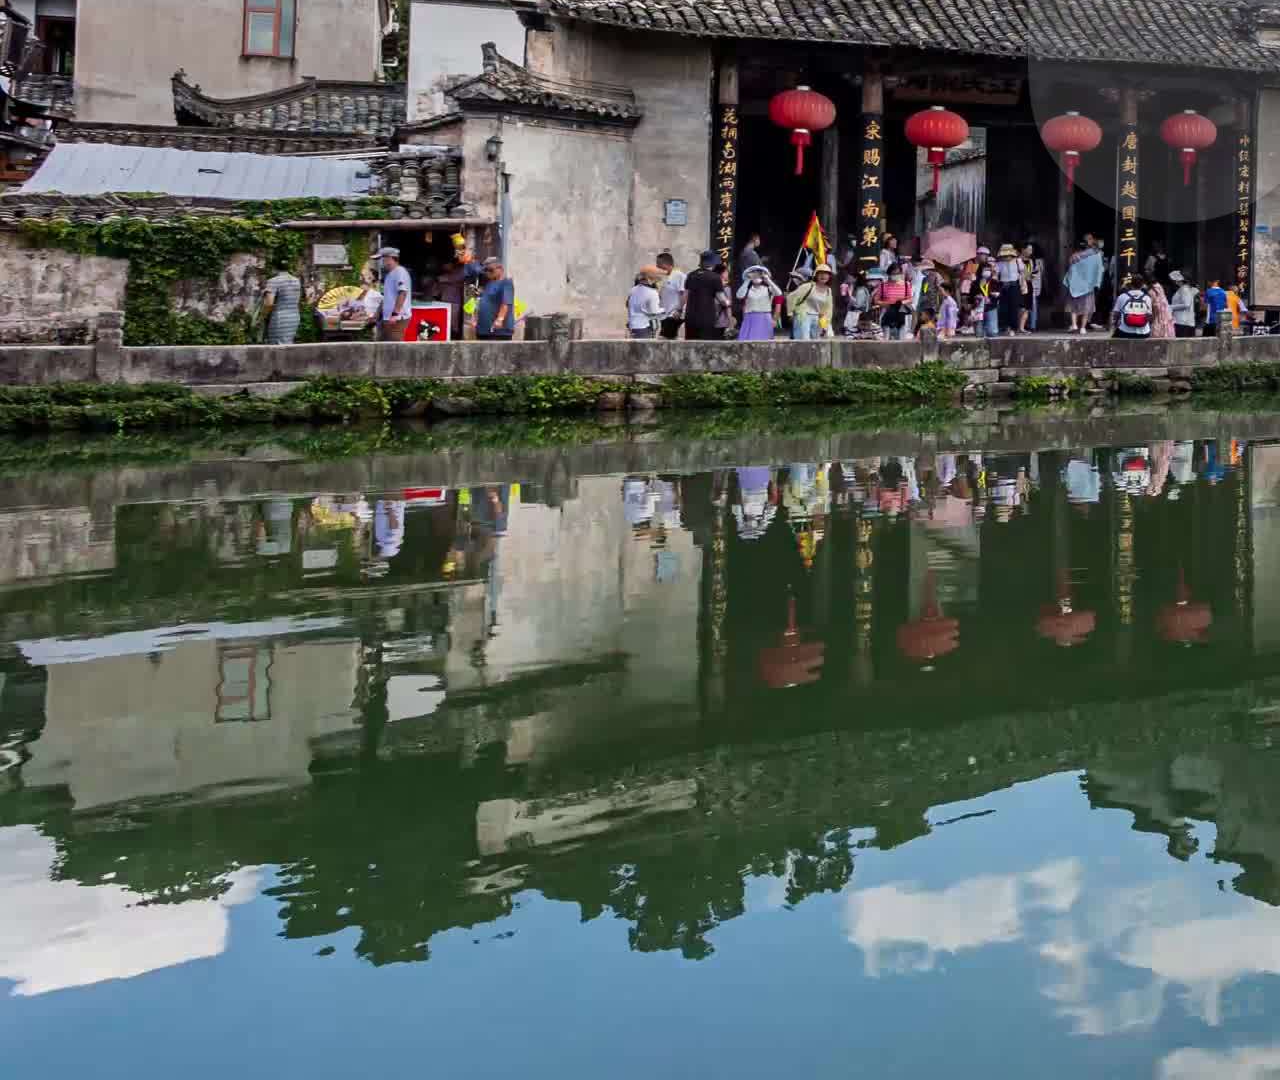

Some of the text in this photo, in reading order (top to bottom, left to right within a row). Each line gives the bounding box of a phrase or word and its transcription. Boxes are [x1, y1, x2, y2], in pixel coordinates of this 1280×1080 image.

[859, 121, 882, 271] 宋赐江南第一
